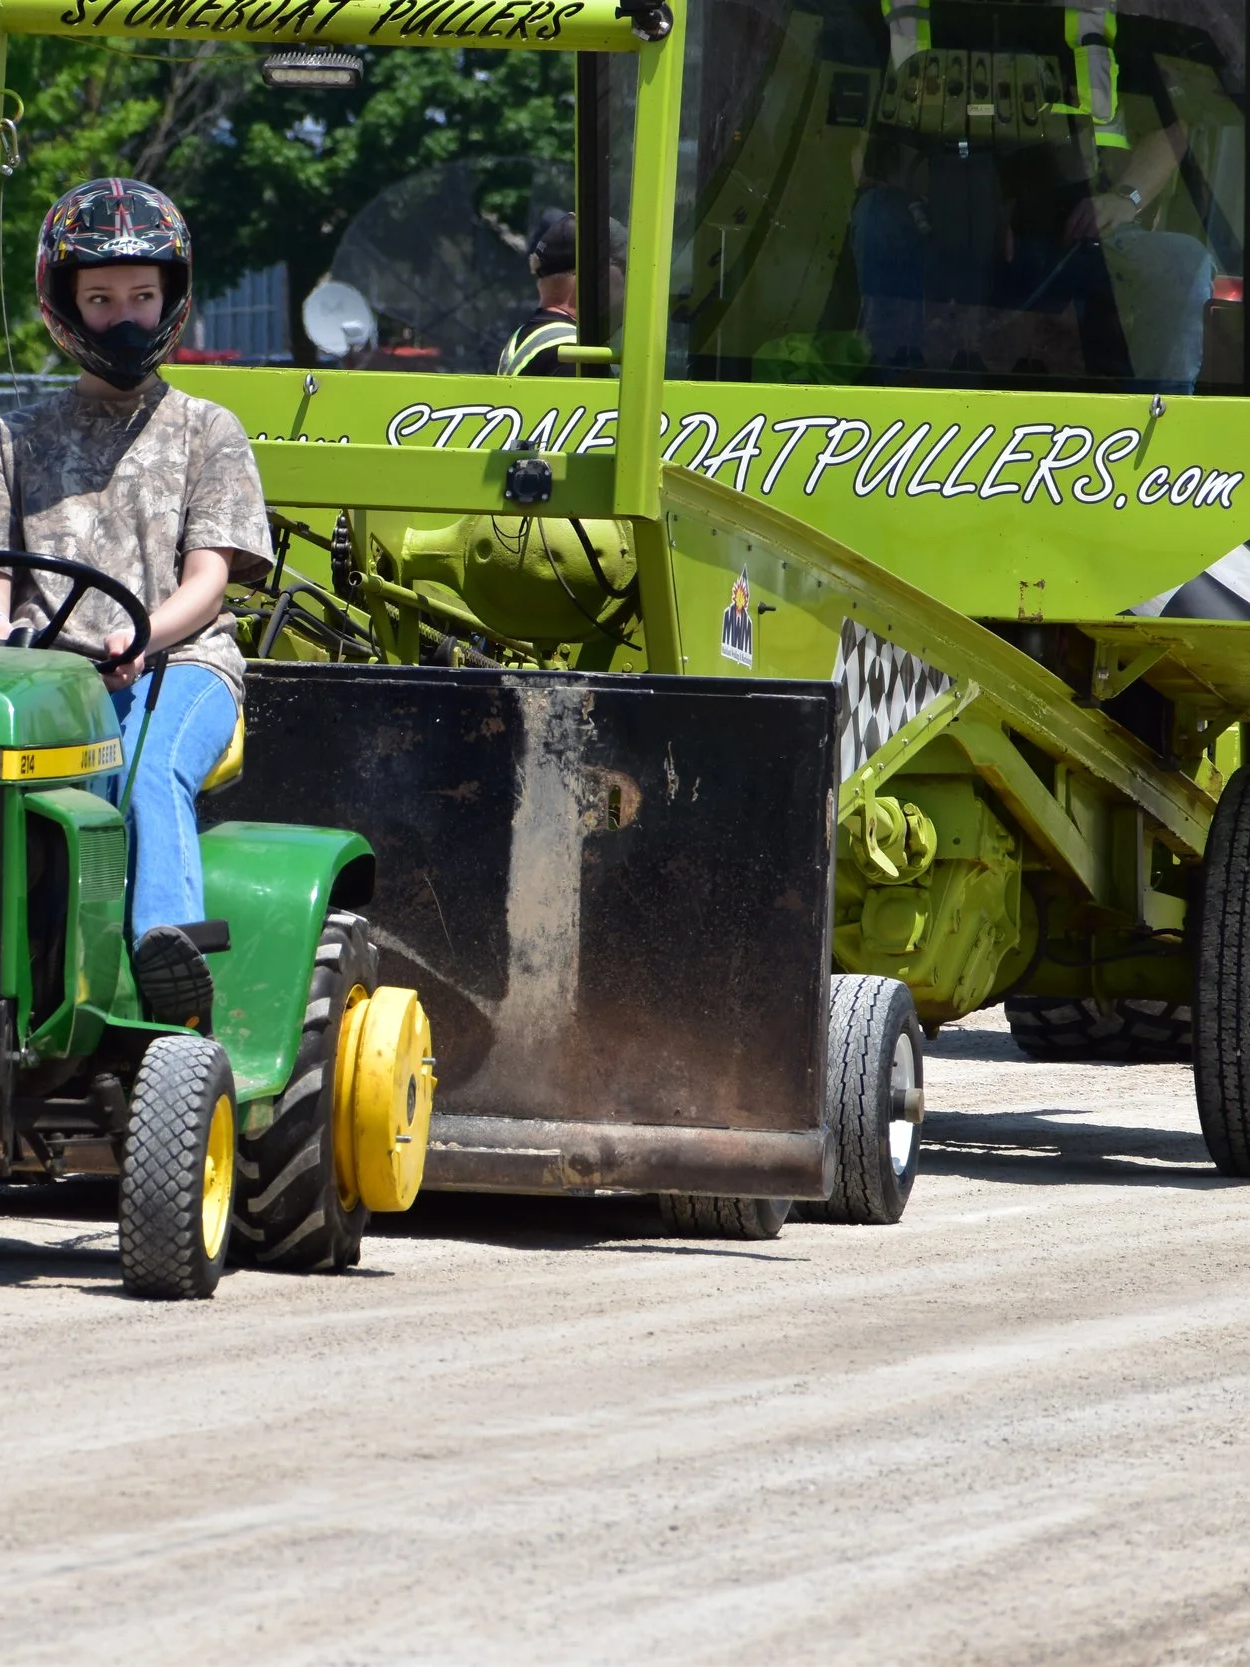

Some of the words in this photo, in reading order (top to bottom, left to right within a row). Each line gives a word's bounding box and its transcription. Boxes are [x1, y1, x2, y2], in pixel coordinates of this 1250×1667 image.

[368, 0, 585, 41] PULLERS
[386, 402, 1245, 509] STONEOATPULLERS.com
[20, 754, 35, 775] 214
[81, 749, 96, 769] JOHN
[98, 744, 117, 766] DEERE
